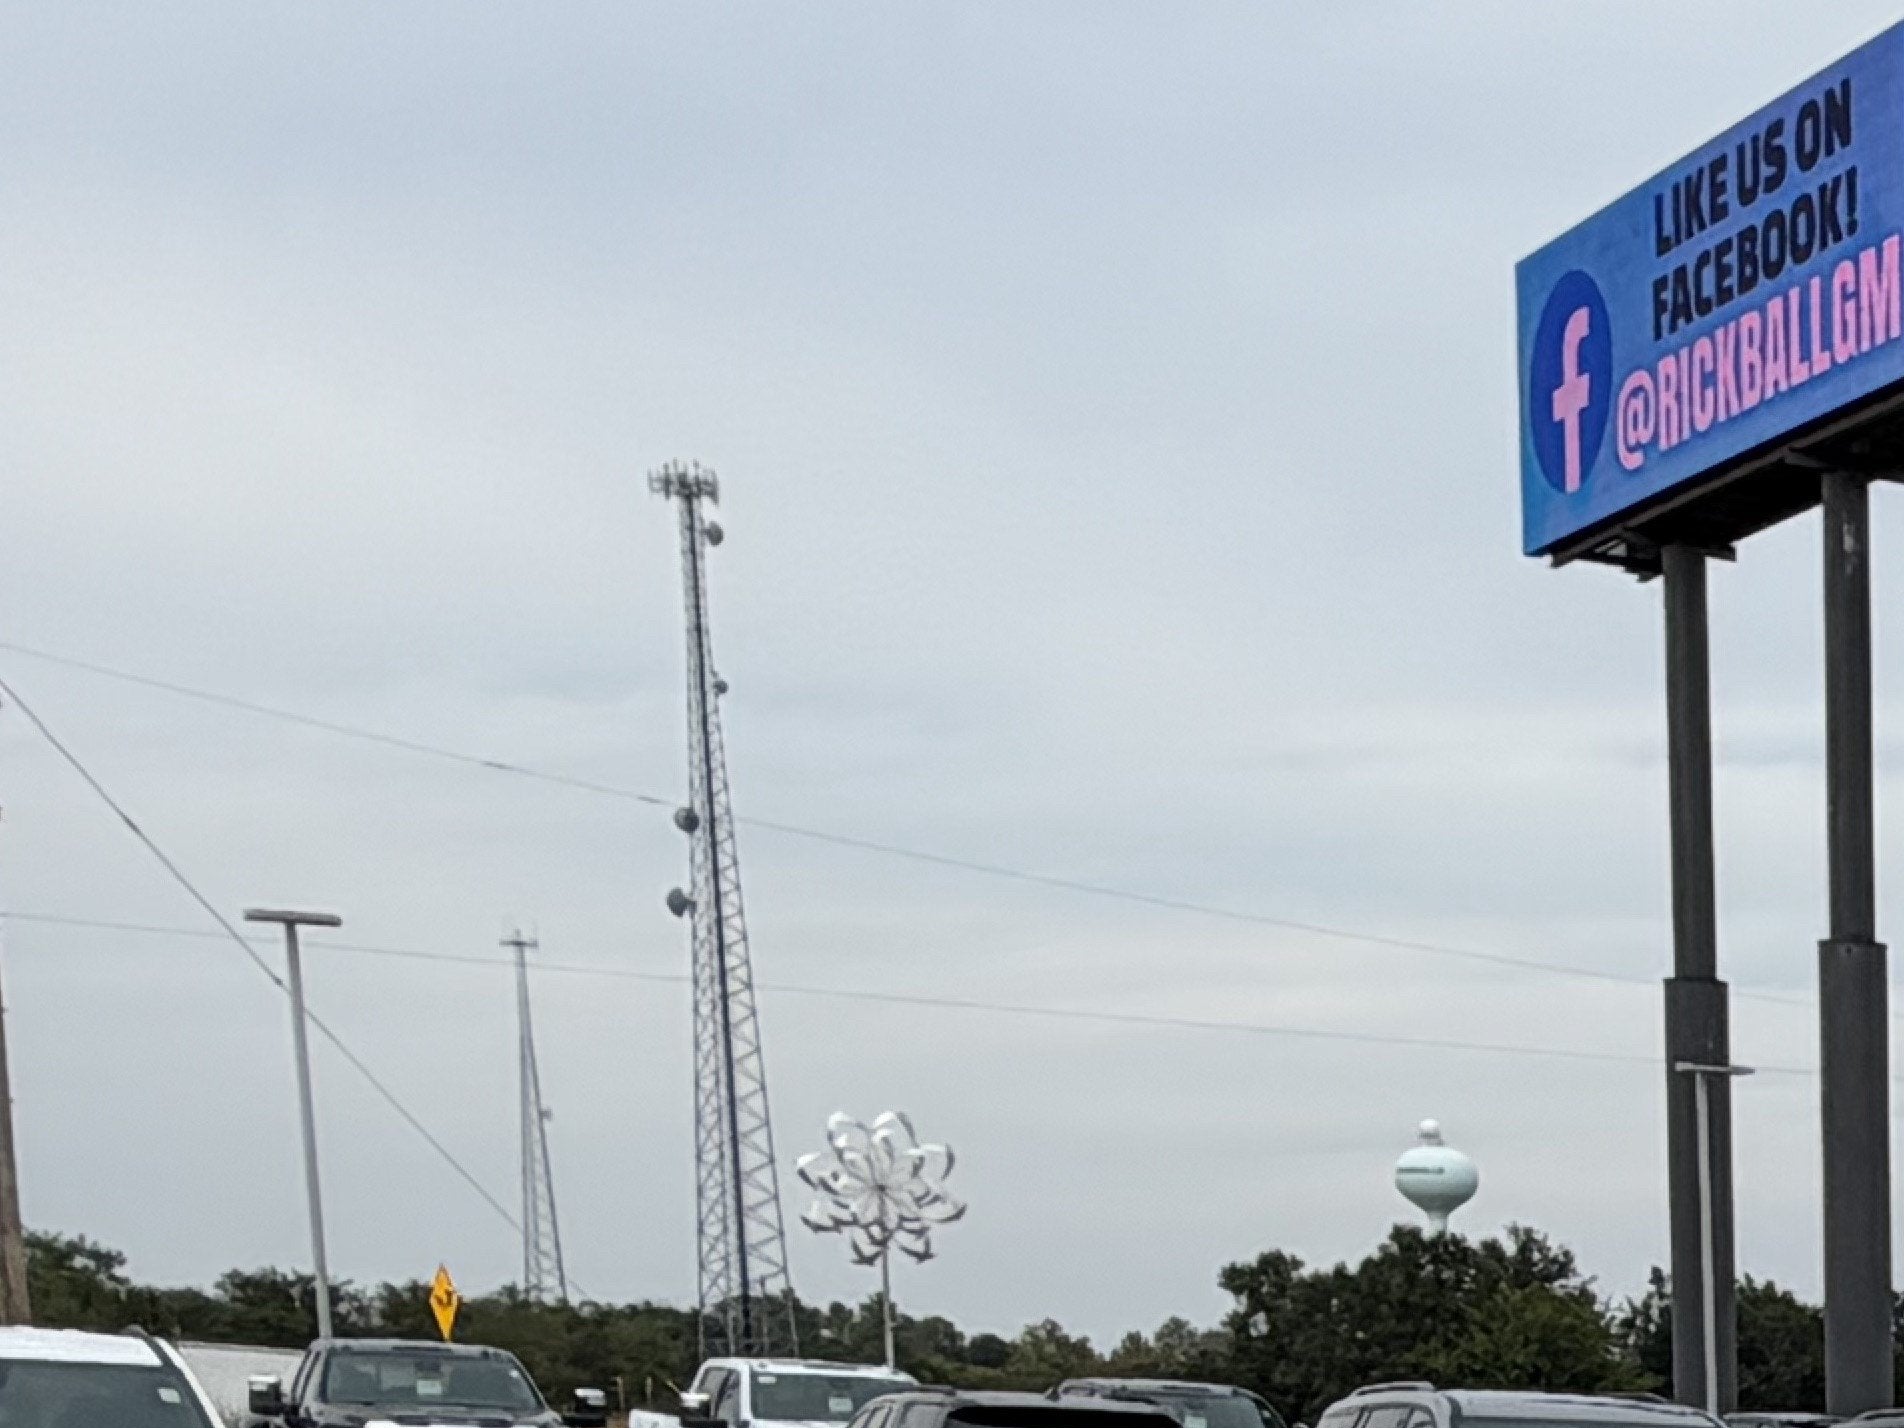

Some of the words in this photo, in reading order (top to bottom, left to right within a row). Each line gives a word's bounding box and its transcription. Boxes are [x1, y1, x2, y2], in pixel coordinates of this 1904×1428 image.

[1652, 165, 1858, 341] FACEBOOK!
[1653, 153, 1729, 258] LIKE
[1736, 116, 1788, 207] US
[1795, 78, 1853, 171] ON
[1617, 234, 1901, 470] @RICKBALLGM
